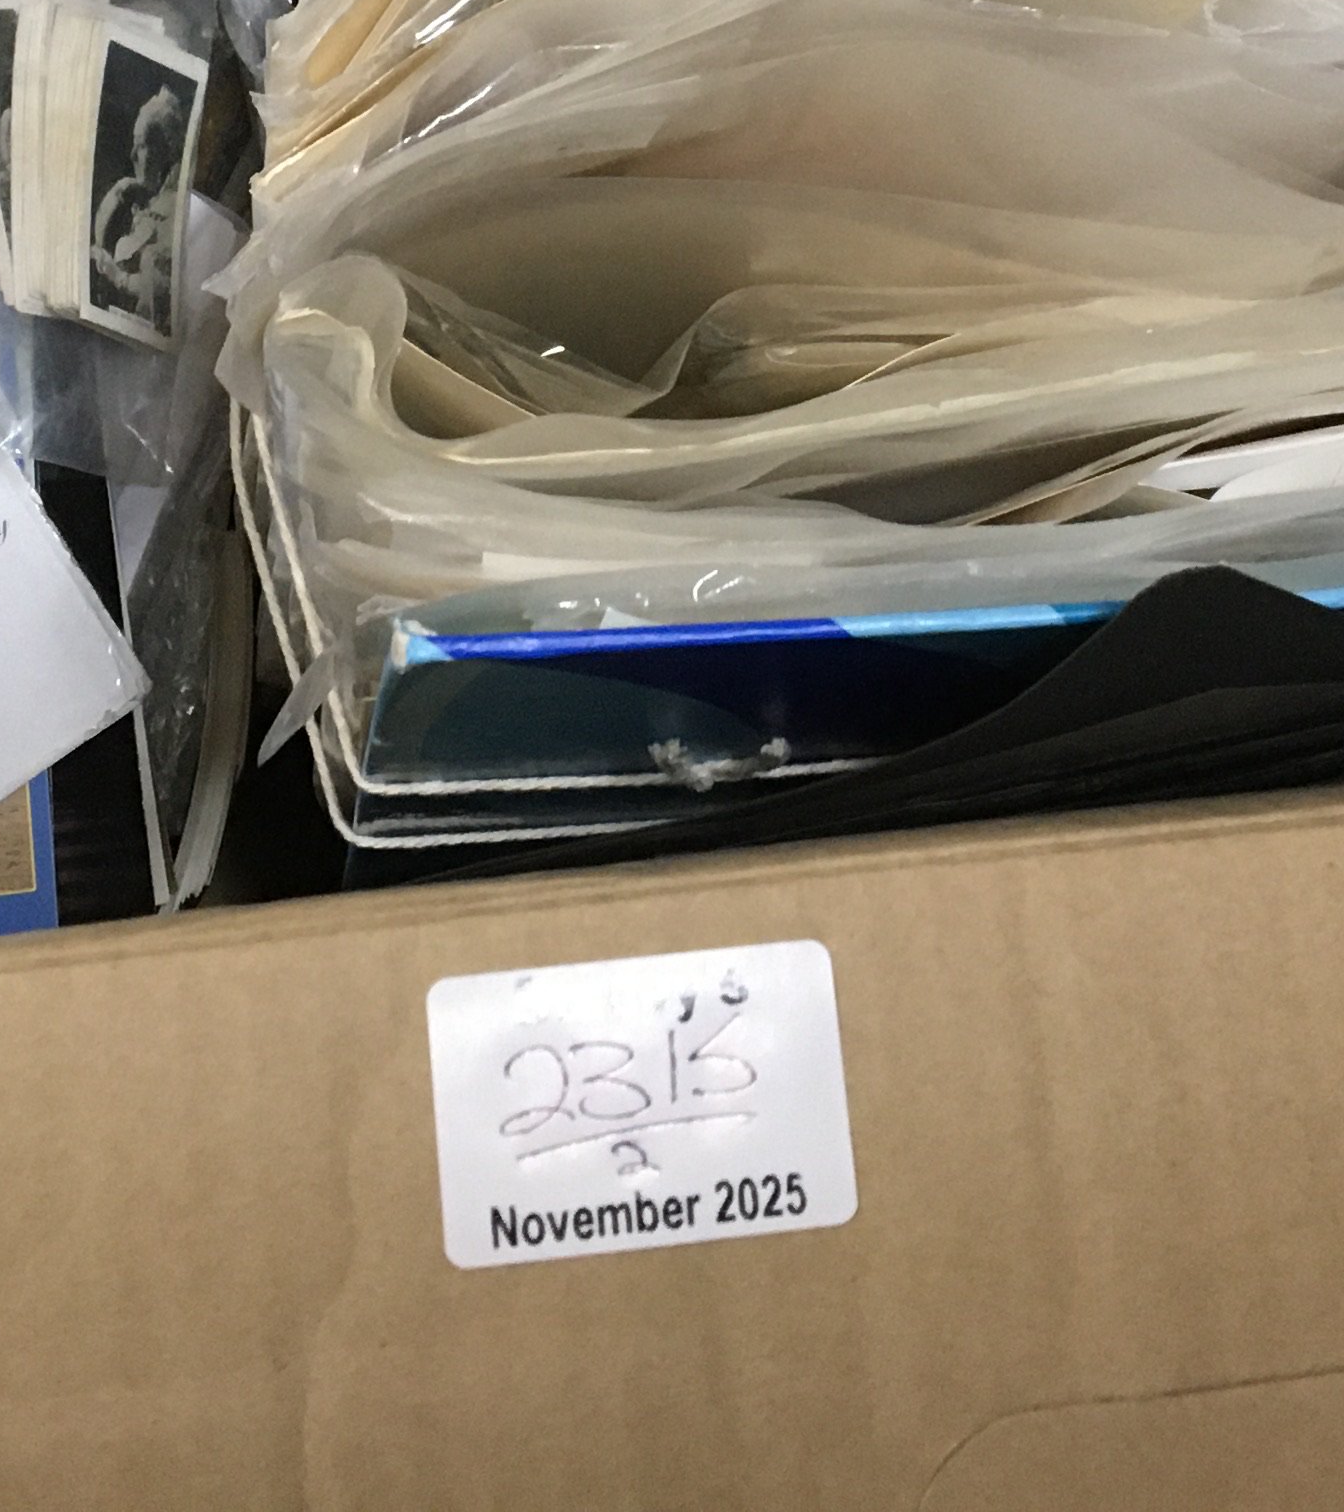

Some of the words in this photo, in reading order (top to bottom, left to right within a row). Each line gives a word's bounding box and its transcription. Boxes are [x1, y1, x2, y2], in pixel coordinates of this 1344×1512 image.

[499, 1012, 757, 1136] 2315
[611, 1141, 660, 1176] 2
[490, 1192, 700, 1248] November
[715, 1172, 807, 1223] 2025
